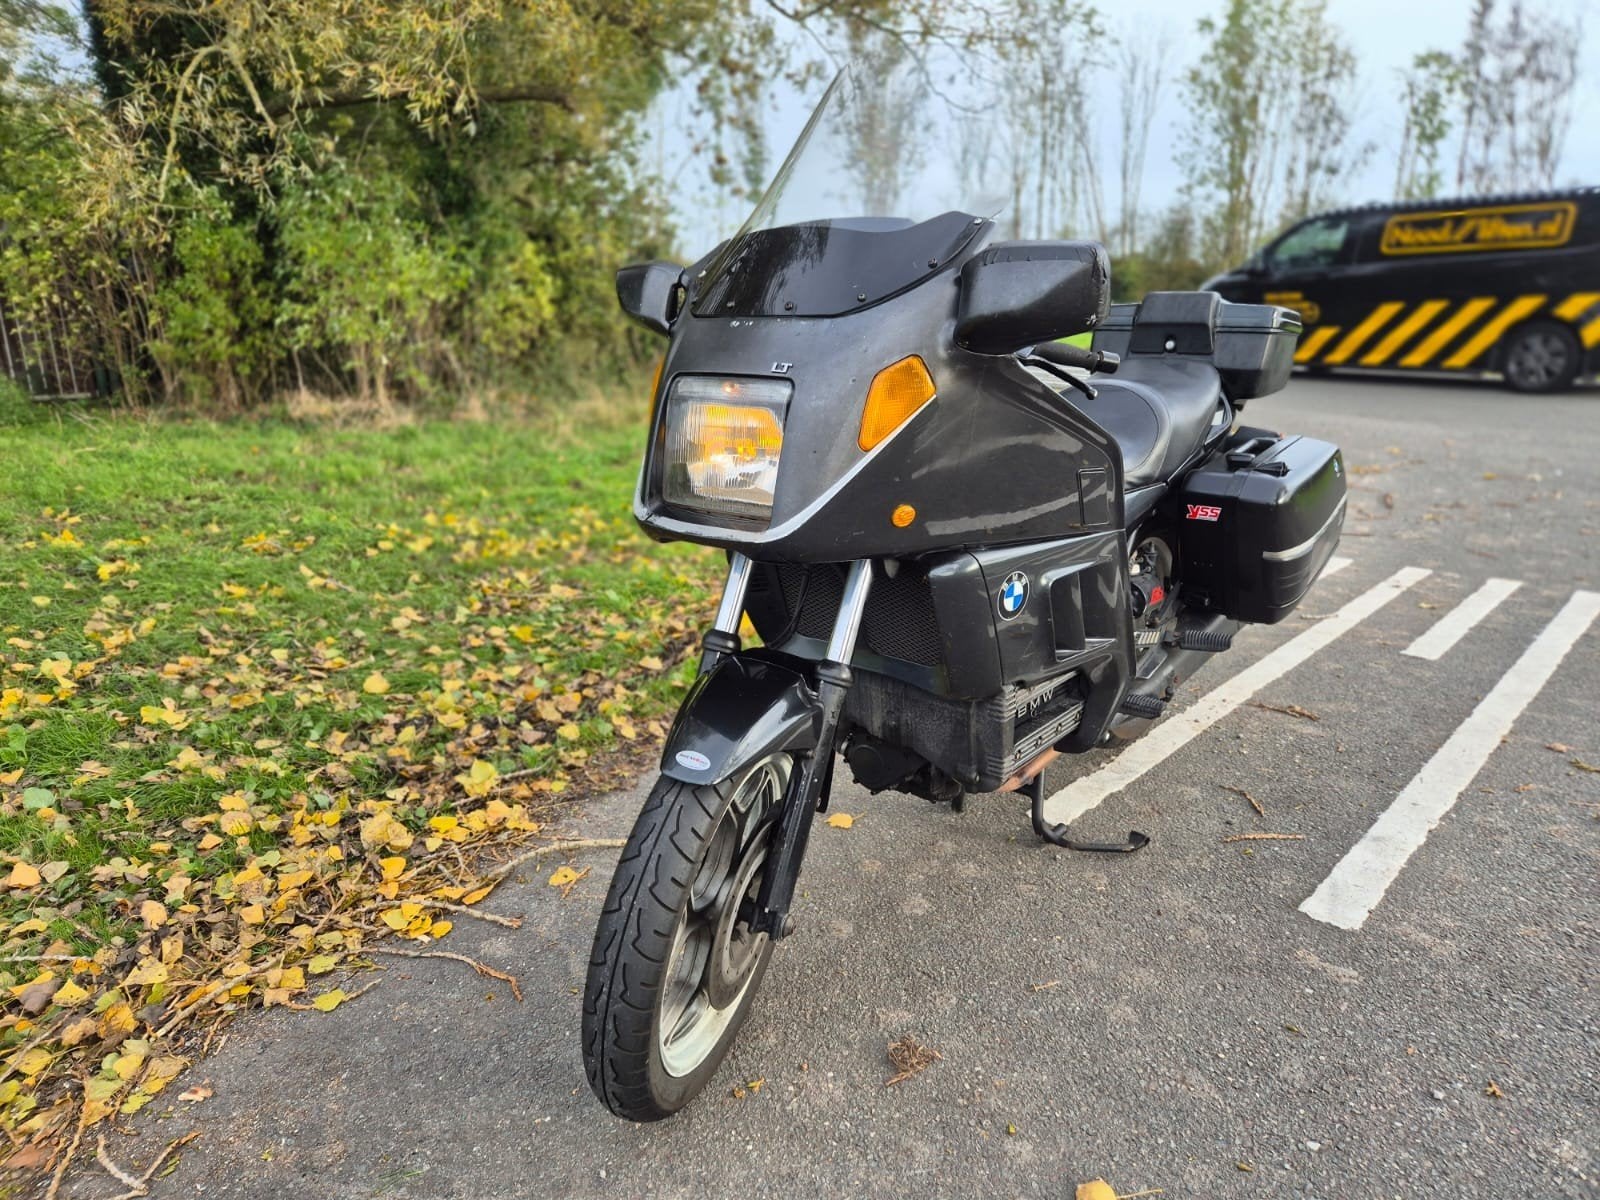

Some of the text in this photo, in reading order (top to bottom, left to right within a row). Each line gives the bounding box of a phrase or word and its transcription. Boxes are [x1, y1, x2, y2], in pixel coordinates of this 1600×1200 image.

[771, 362, 793, 373] LT
[1186, 504, 1221, 520] YSS
[1017, 688, 1054, 718] BMW
